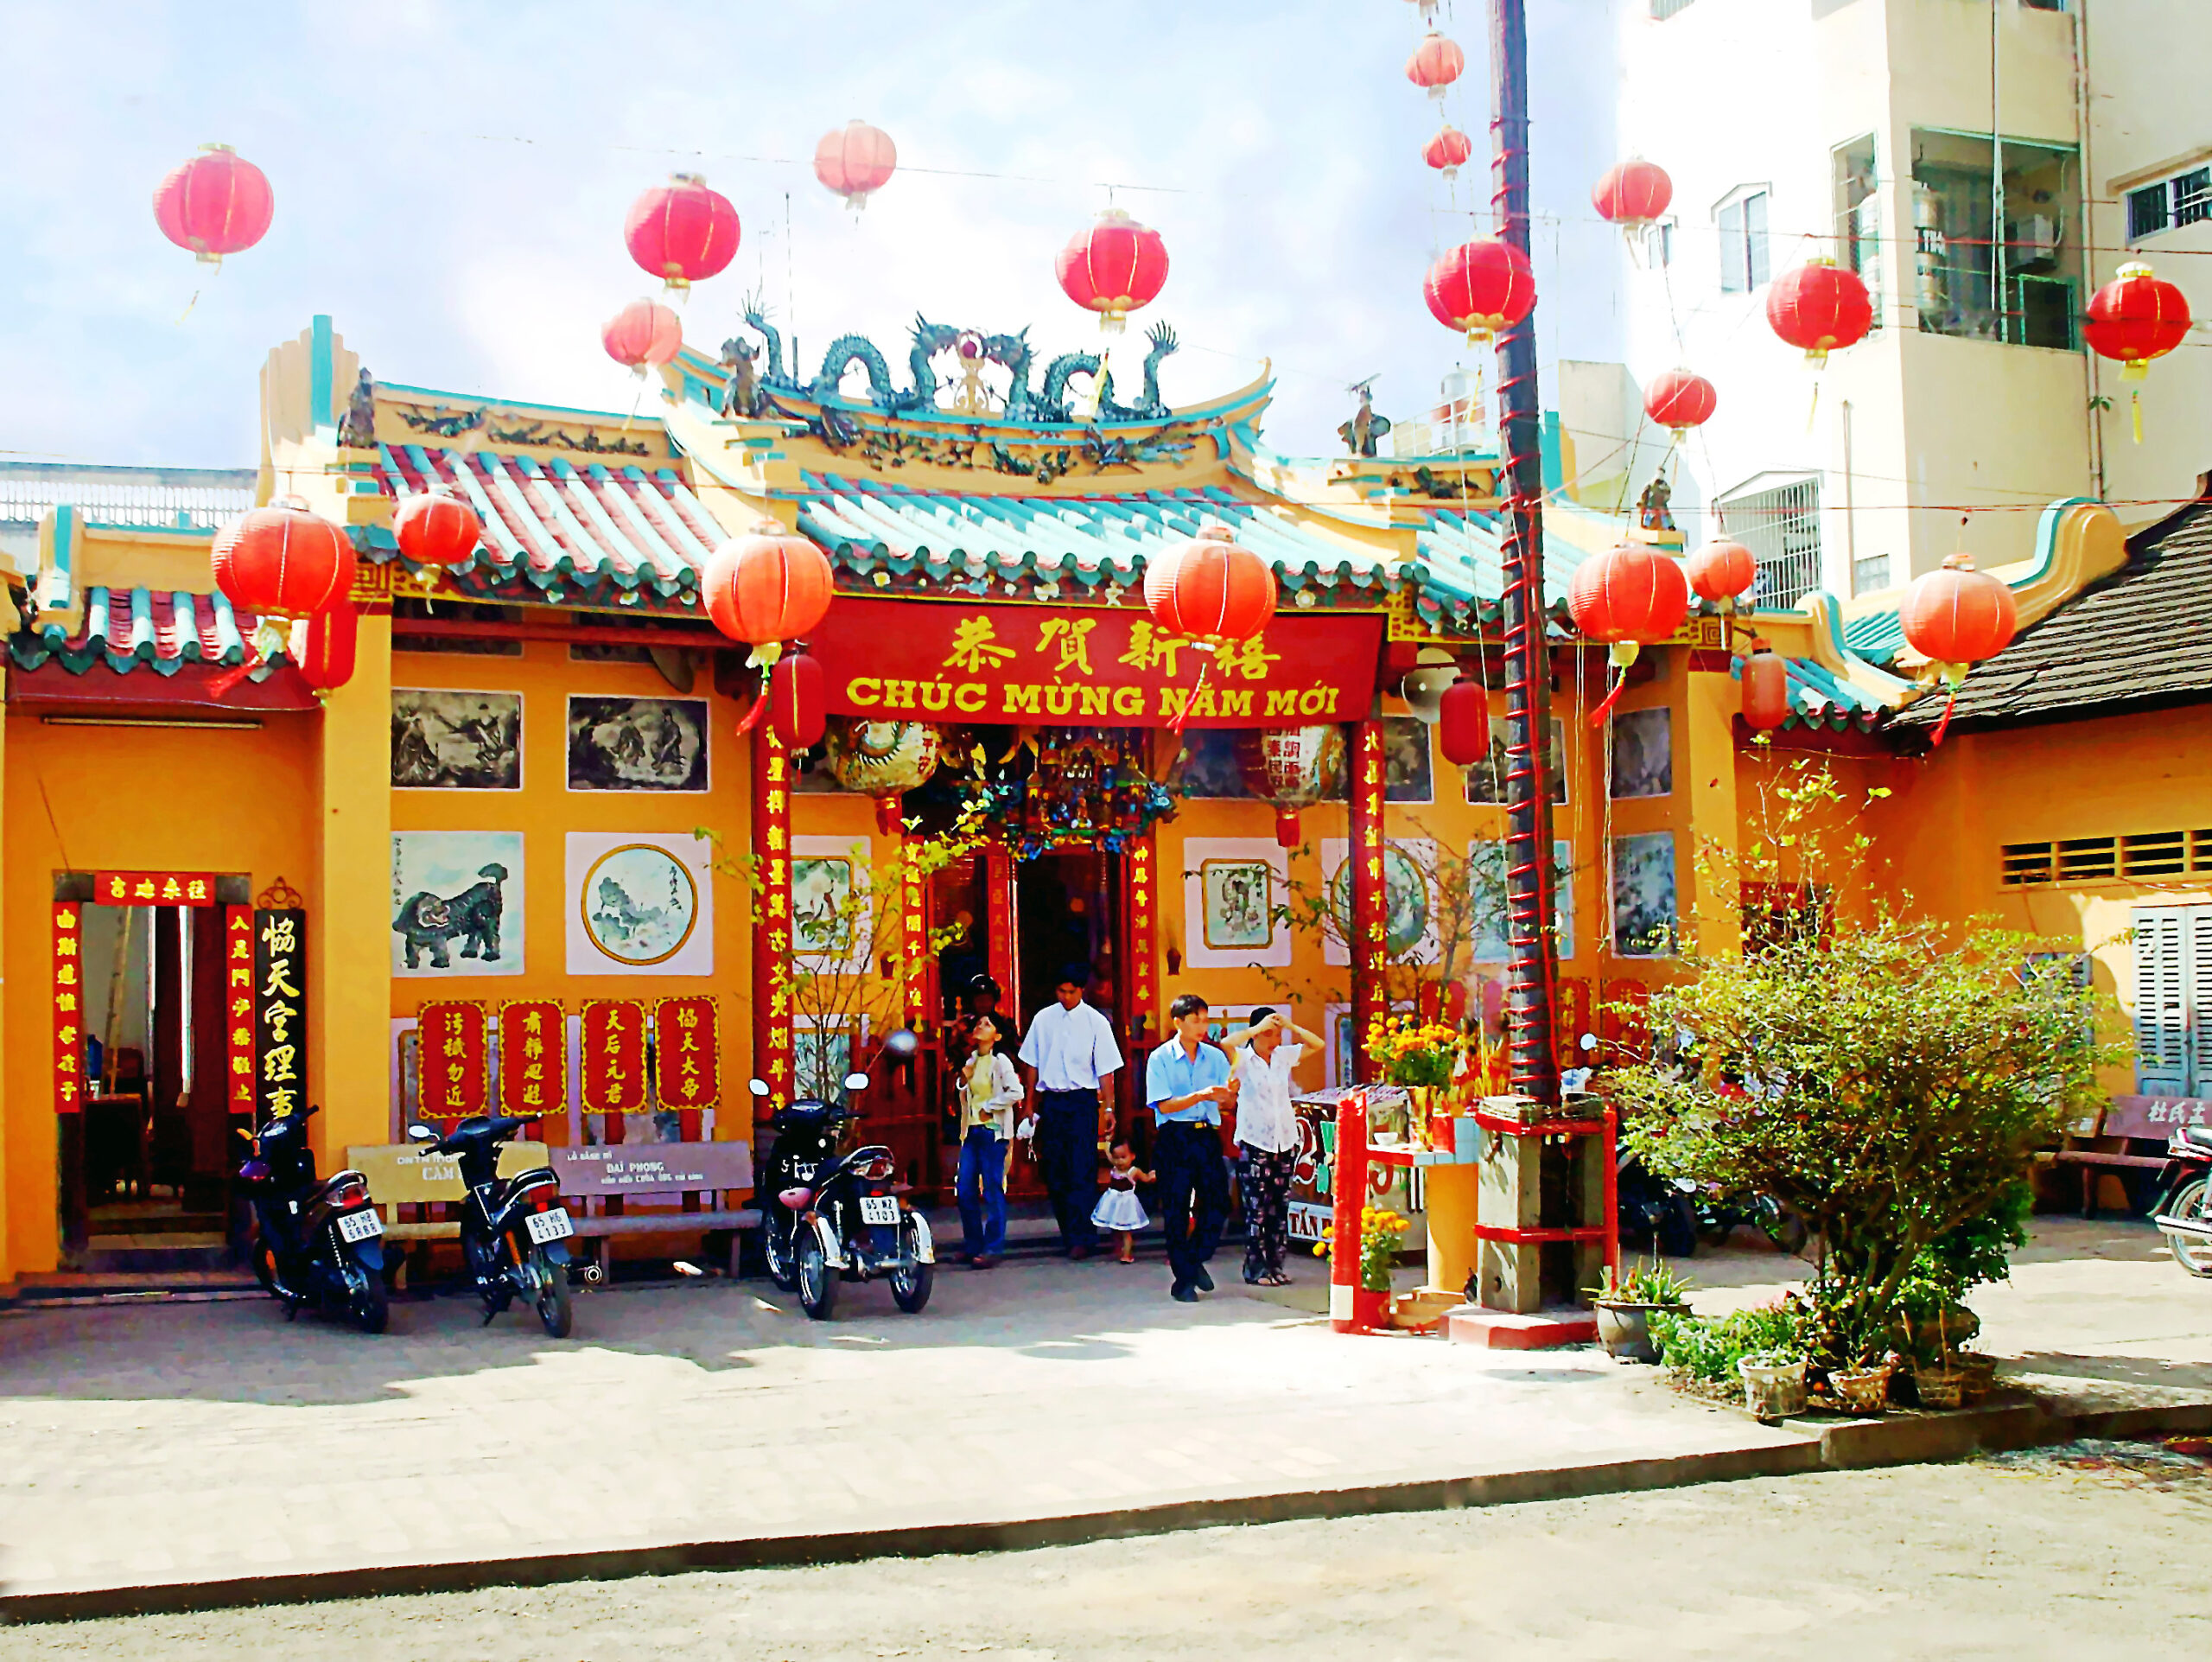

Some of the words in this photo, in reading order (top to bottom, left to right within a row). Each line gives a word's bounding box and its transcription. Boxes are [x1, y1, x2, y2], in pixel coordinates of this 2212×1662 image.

[846, 673, 988, 711] CHÚC
[1002, 675, 1145, 716] MỪNG
[1158, 683, 1255, 716] NĂM
[1263, 684, 1338, 716] MỚI
[532, 1216, 544, 1228] 65
